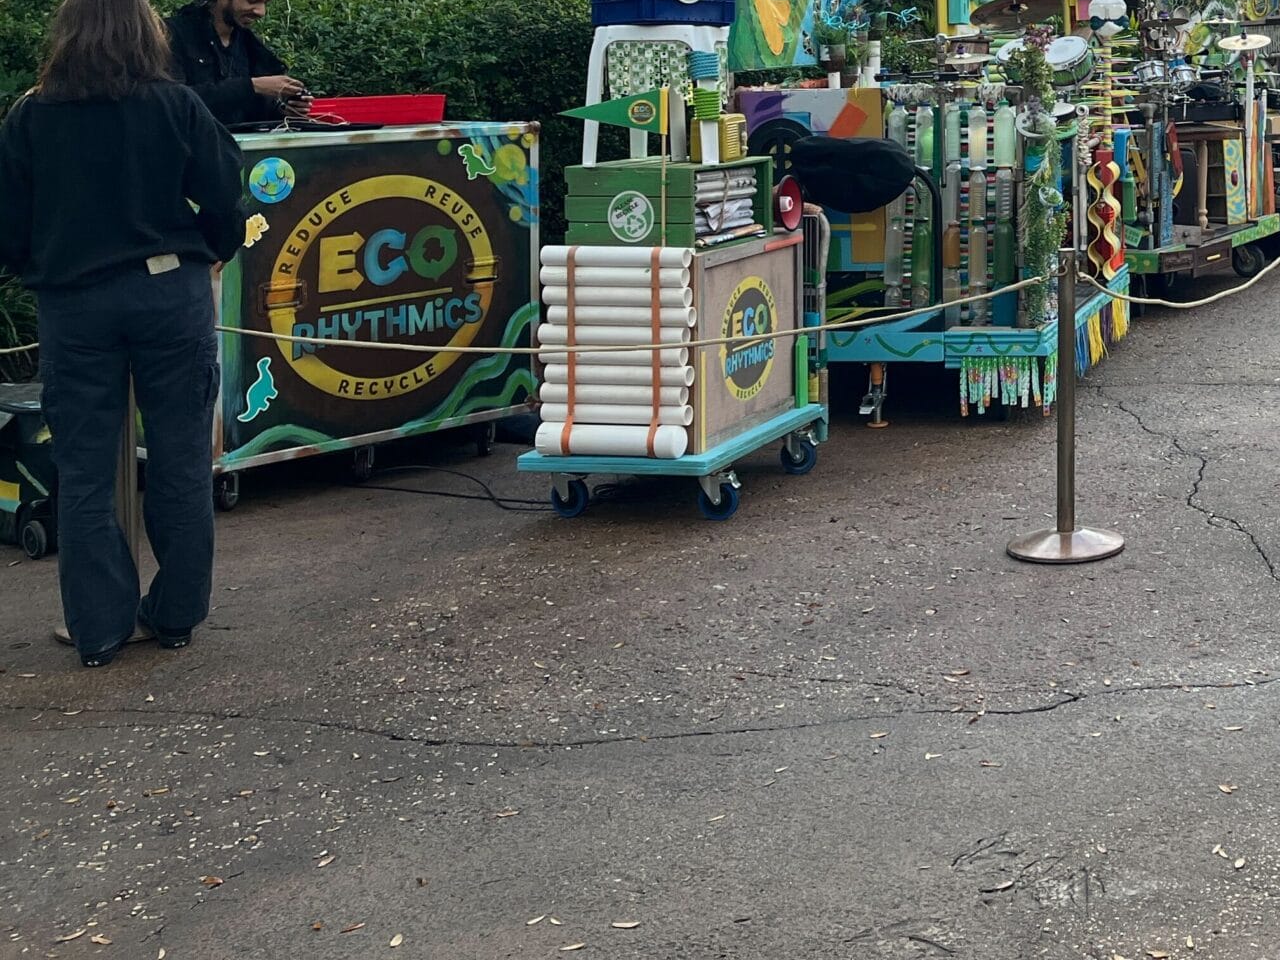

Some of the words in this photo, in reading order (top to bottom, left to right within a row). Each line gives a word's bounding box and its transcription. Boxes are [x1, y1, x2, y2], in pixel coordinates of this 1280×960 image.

[278, 190, 352, 276] REDUCE
[424, 184, 483, 239] REUSE
[318, 224, 459, 294] ECO
[731, 303, 768, 337] ECO
[337, 362, 437, 396] RECYCLE
